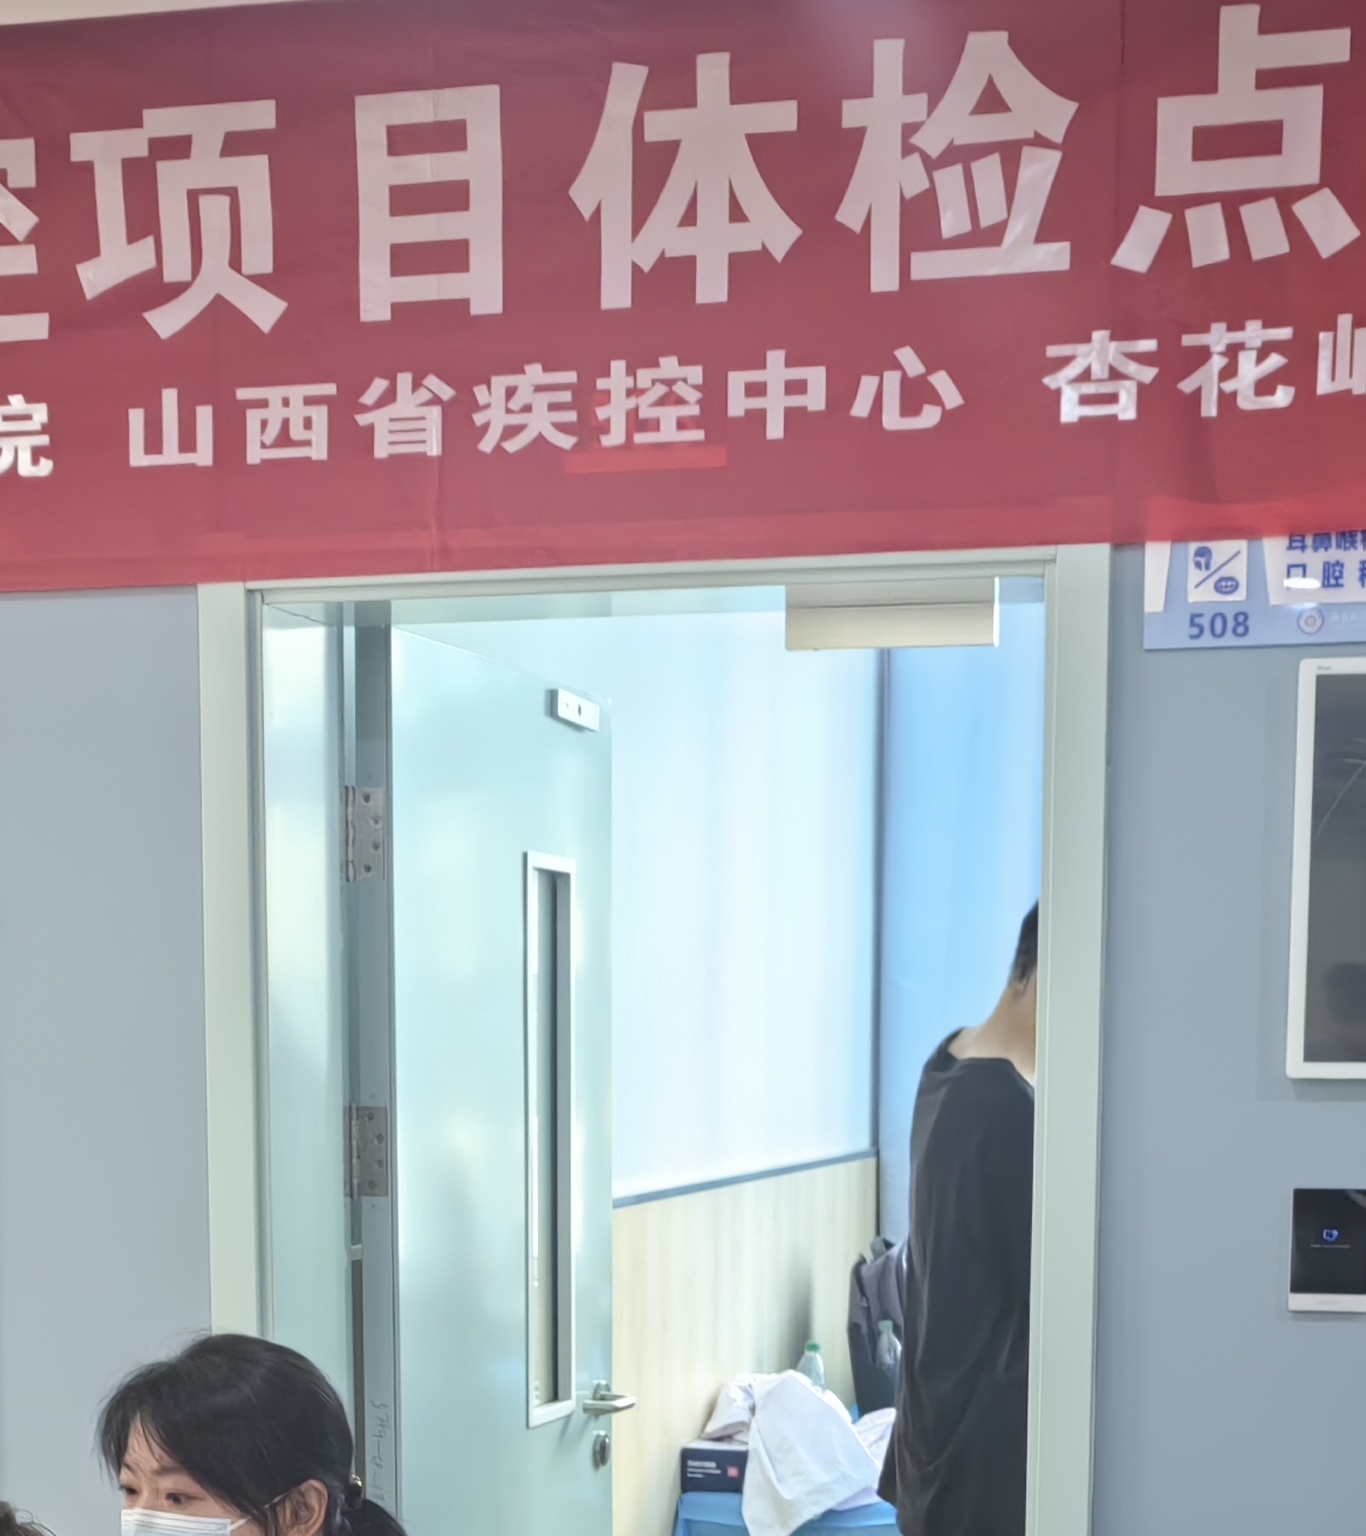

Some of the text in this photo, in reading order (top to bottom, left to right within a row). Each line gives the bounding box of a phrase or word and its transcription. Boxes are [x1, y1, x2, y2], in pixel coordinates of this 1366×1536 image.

[128, 345, 965, 469] 山西省疾控中心
[1188, 611, 1250, 640] 508
